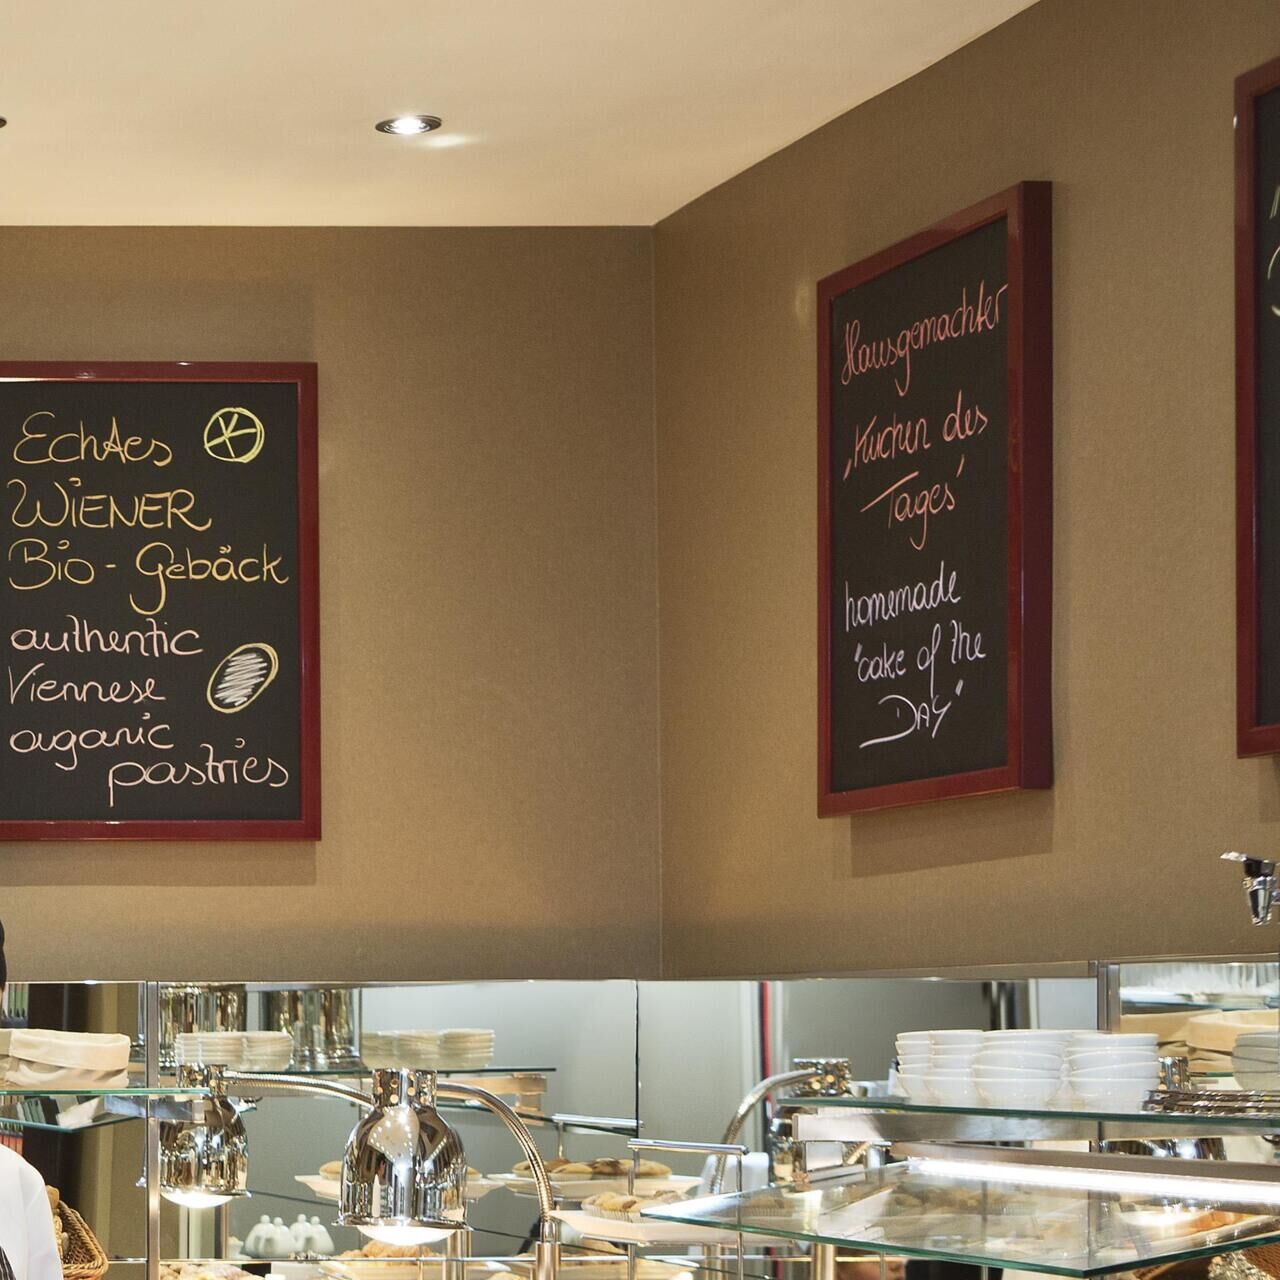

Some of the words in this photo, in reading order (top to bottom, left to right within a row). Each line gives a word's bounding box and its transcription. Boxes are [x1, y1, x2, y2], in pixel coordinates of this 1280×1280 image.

[841, 280, 1008, 396] Hausgemachter
[13, 411, 172, 466] Echtes
[943, 390, 988, 445] des
[845, 561, 960, 632] homemade
[10, 614, 203, 657] authentic
[917, 623, 942, 697] of
[950, 619, 986, 659] the
[8, 663, 166, 704] Viennese
[9, 712, 174, 770] organic
[108, 738, 289, 807] pastries
